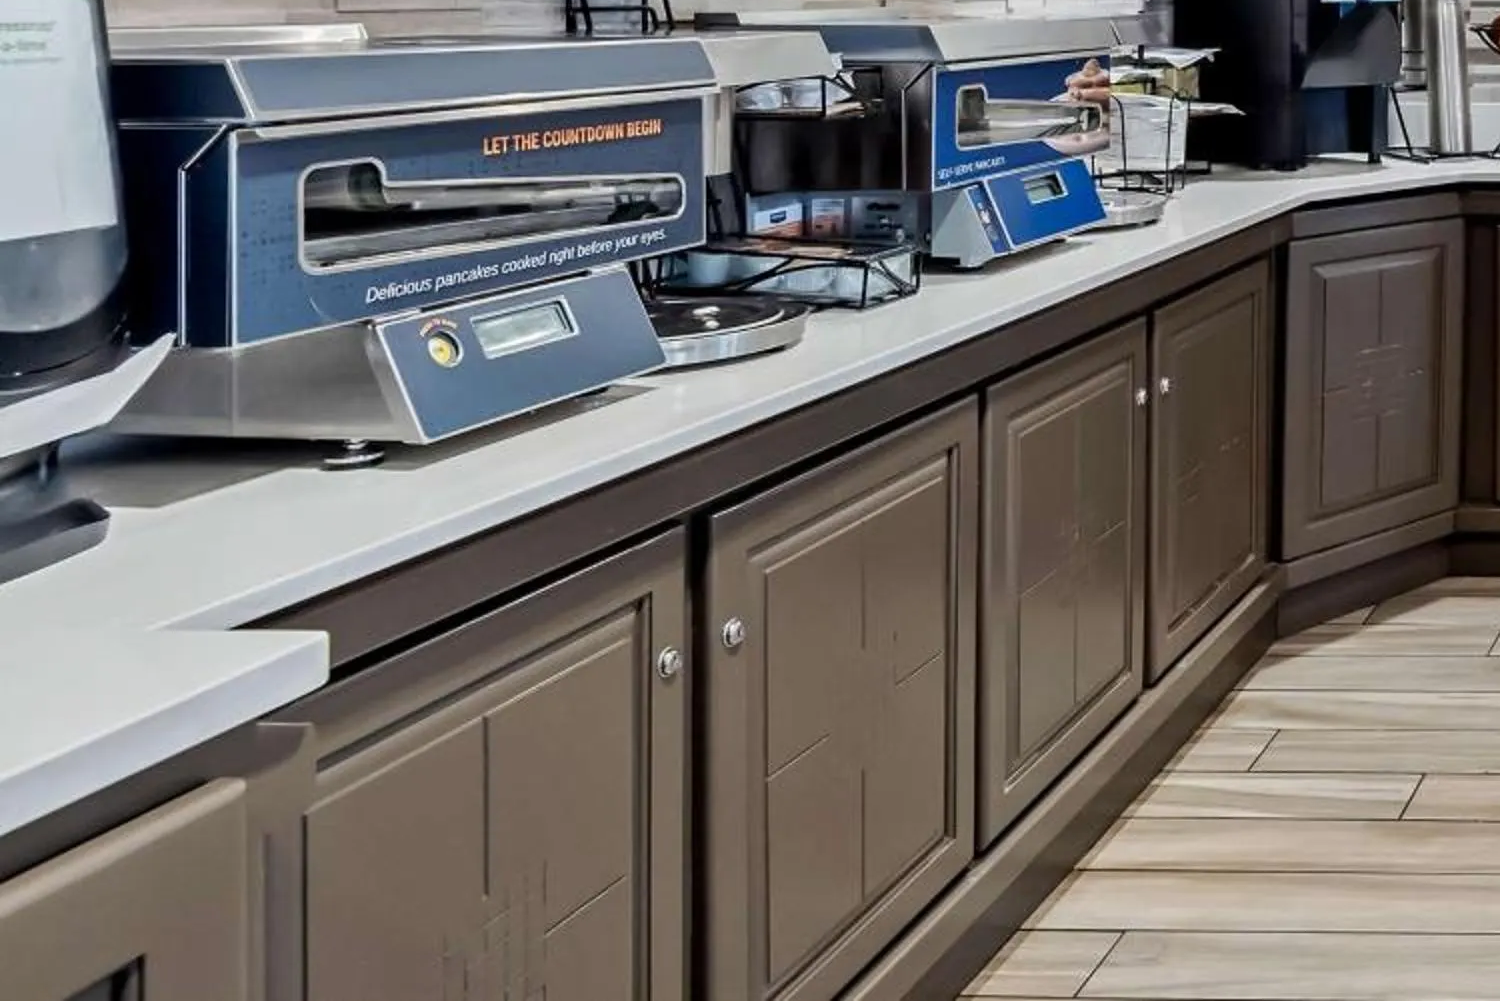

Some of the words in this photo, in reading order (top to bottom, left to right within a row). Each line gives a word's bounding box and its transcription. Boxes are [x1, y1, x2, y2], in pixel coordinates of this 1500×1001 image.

[483, 135, 510, 156] LET
[512, 132, 540, 152] THE
[542, 123, 624, 148] COUNTDOWN
[626, 119, 662, 137] BEGIN
[365, 278, 433, 304] Delicious
[434, 264, 500, 292] pancakes
[501, 251, 547, 274] cooked
[549, 246, 576, 266] right
[577, 239, 613, 259] before
[614, 233, 640, 254] your
